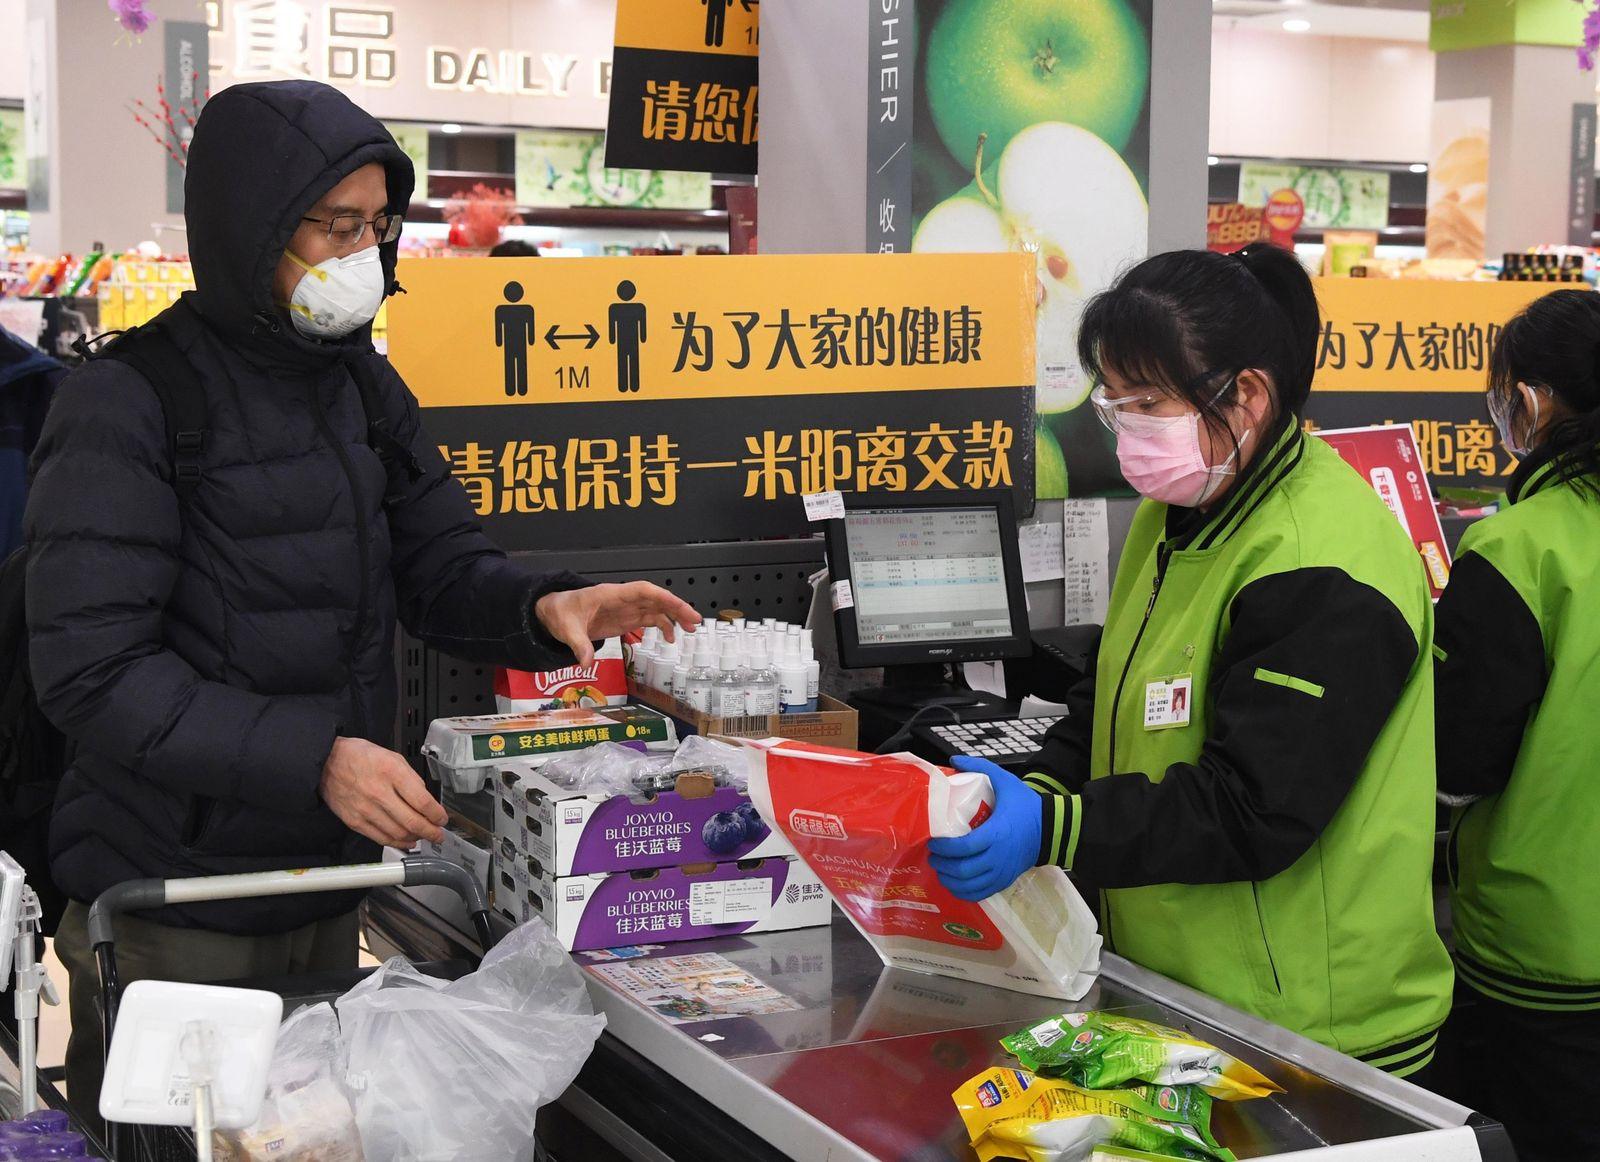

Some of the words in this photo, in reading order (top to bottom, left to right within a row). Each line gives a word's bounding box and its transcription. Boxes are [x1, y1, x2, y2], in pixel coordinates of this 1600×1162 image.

[431, 49, 579, 95] DAILY
[671, 305, 983, 373] 为了大家的健康
[555, 366, 590, 389] 1M
[437, 419, 1014, 516] 请您保持一米距离交款
[519, 727, 610, 749] 安全美味鲜鸡蛋
[623, 811, 673, 826] JOYVIO
[605, 822, 692, 840] BLUEBERRIES
[615, 836, 682, 858] 佳沃蓝莓
[625, 888, 675, 903] JOYVIO
[802, 883, 823, 894] 佳沃
[802, 893, 823, 902] JOYVIO
[607, 898, 691, 917] BLUEBERRIES
[616, 913, 683, 935] 佳沃蓝莓
